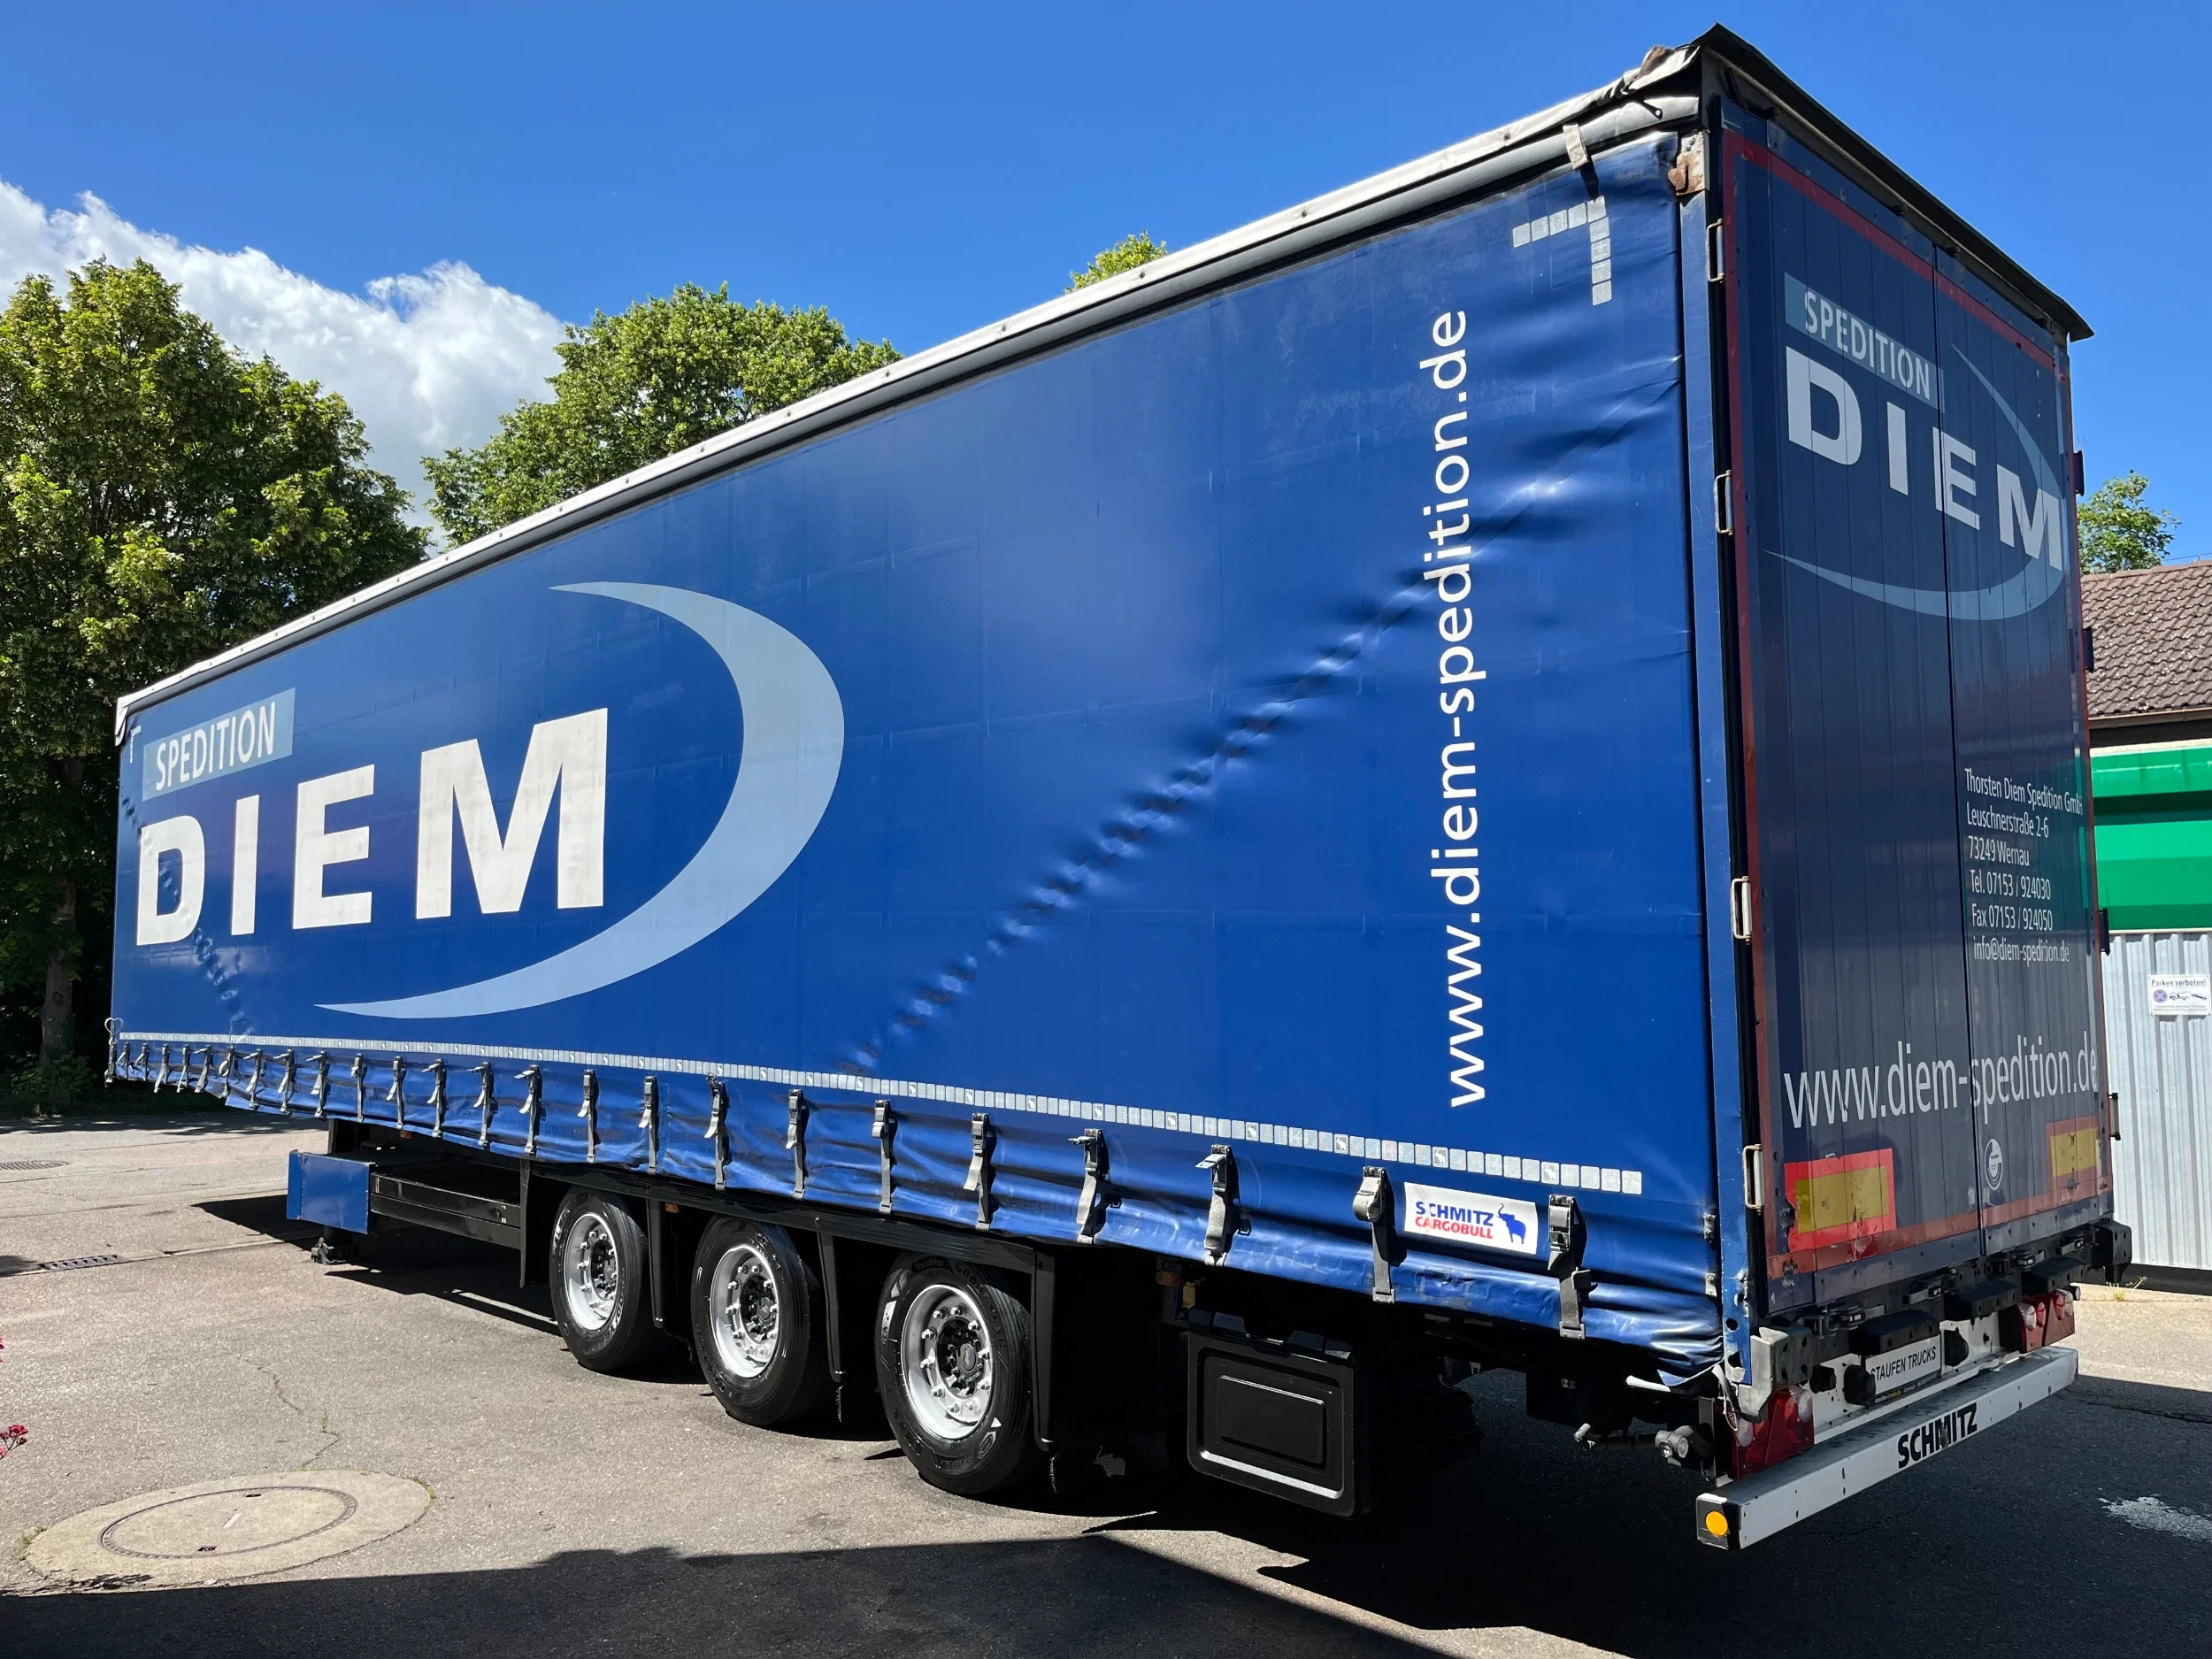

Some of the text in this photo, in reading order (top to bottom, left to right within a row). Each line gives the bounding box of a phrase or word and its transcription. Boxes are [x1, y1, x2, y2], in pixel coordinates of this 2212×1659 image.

[1804, 289, 1931, 400] SPEDITION
[1786, 345, 2062, 572] DIEM
[1419, 310, 1486, 1108] www.diem-spedition.de
[156, 702, 276, 791] SPEDITION
[1964, 768, 2084, 816] Thorsten Diem Spedition GmbH
[136, 707, 608, 947] DIEM
[1966, 802, 2049, 838] Leuschnerstraße 2-6
[1968, 835, 2030, 866] 73249 Wernau
[1970, 869, 1985, 894] Tel.
[1986, 871, 2014, 896] 07153
[2021, 877, 2051, 900] 924030
[1971, 902, 1987, 928] Fax
[1988, 904, 2016, 929] 07153
[2023, 907, 2053, 932] 924050
[1973, 935, 2070, 967] info@diem-spedition.de
[1784, 1031, 2099, 1129] www.diem-spedition.de
[1415, 1216, 1494, 1240] CARGOBULL
[1416, 1201, 1494, 1227] SCHMITZ
[1870, 1346, 1936, 1381] STAUFEN TRUCKS
[1897, 1402, 1978, 1469] SCHMITZ
